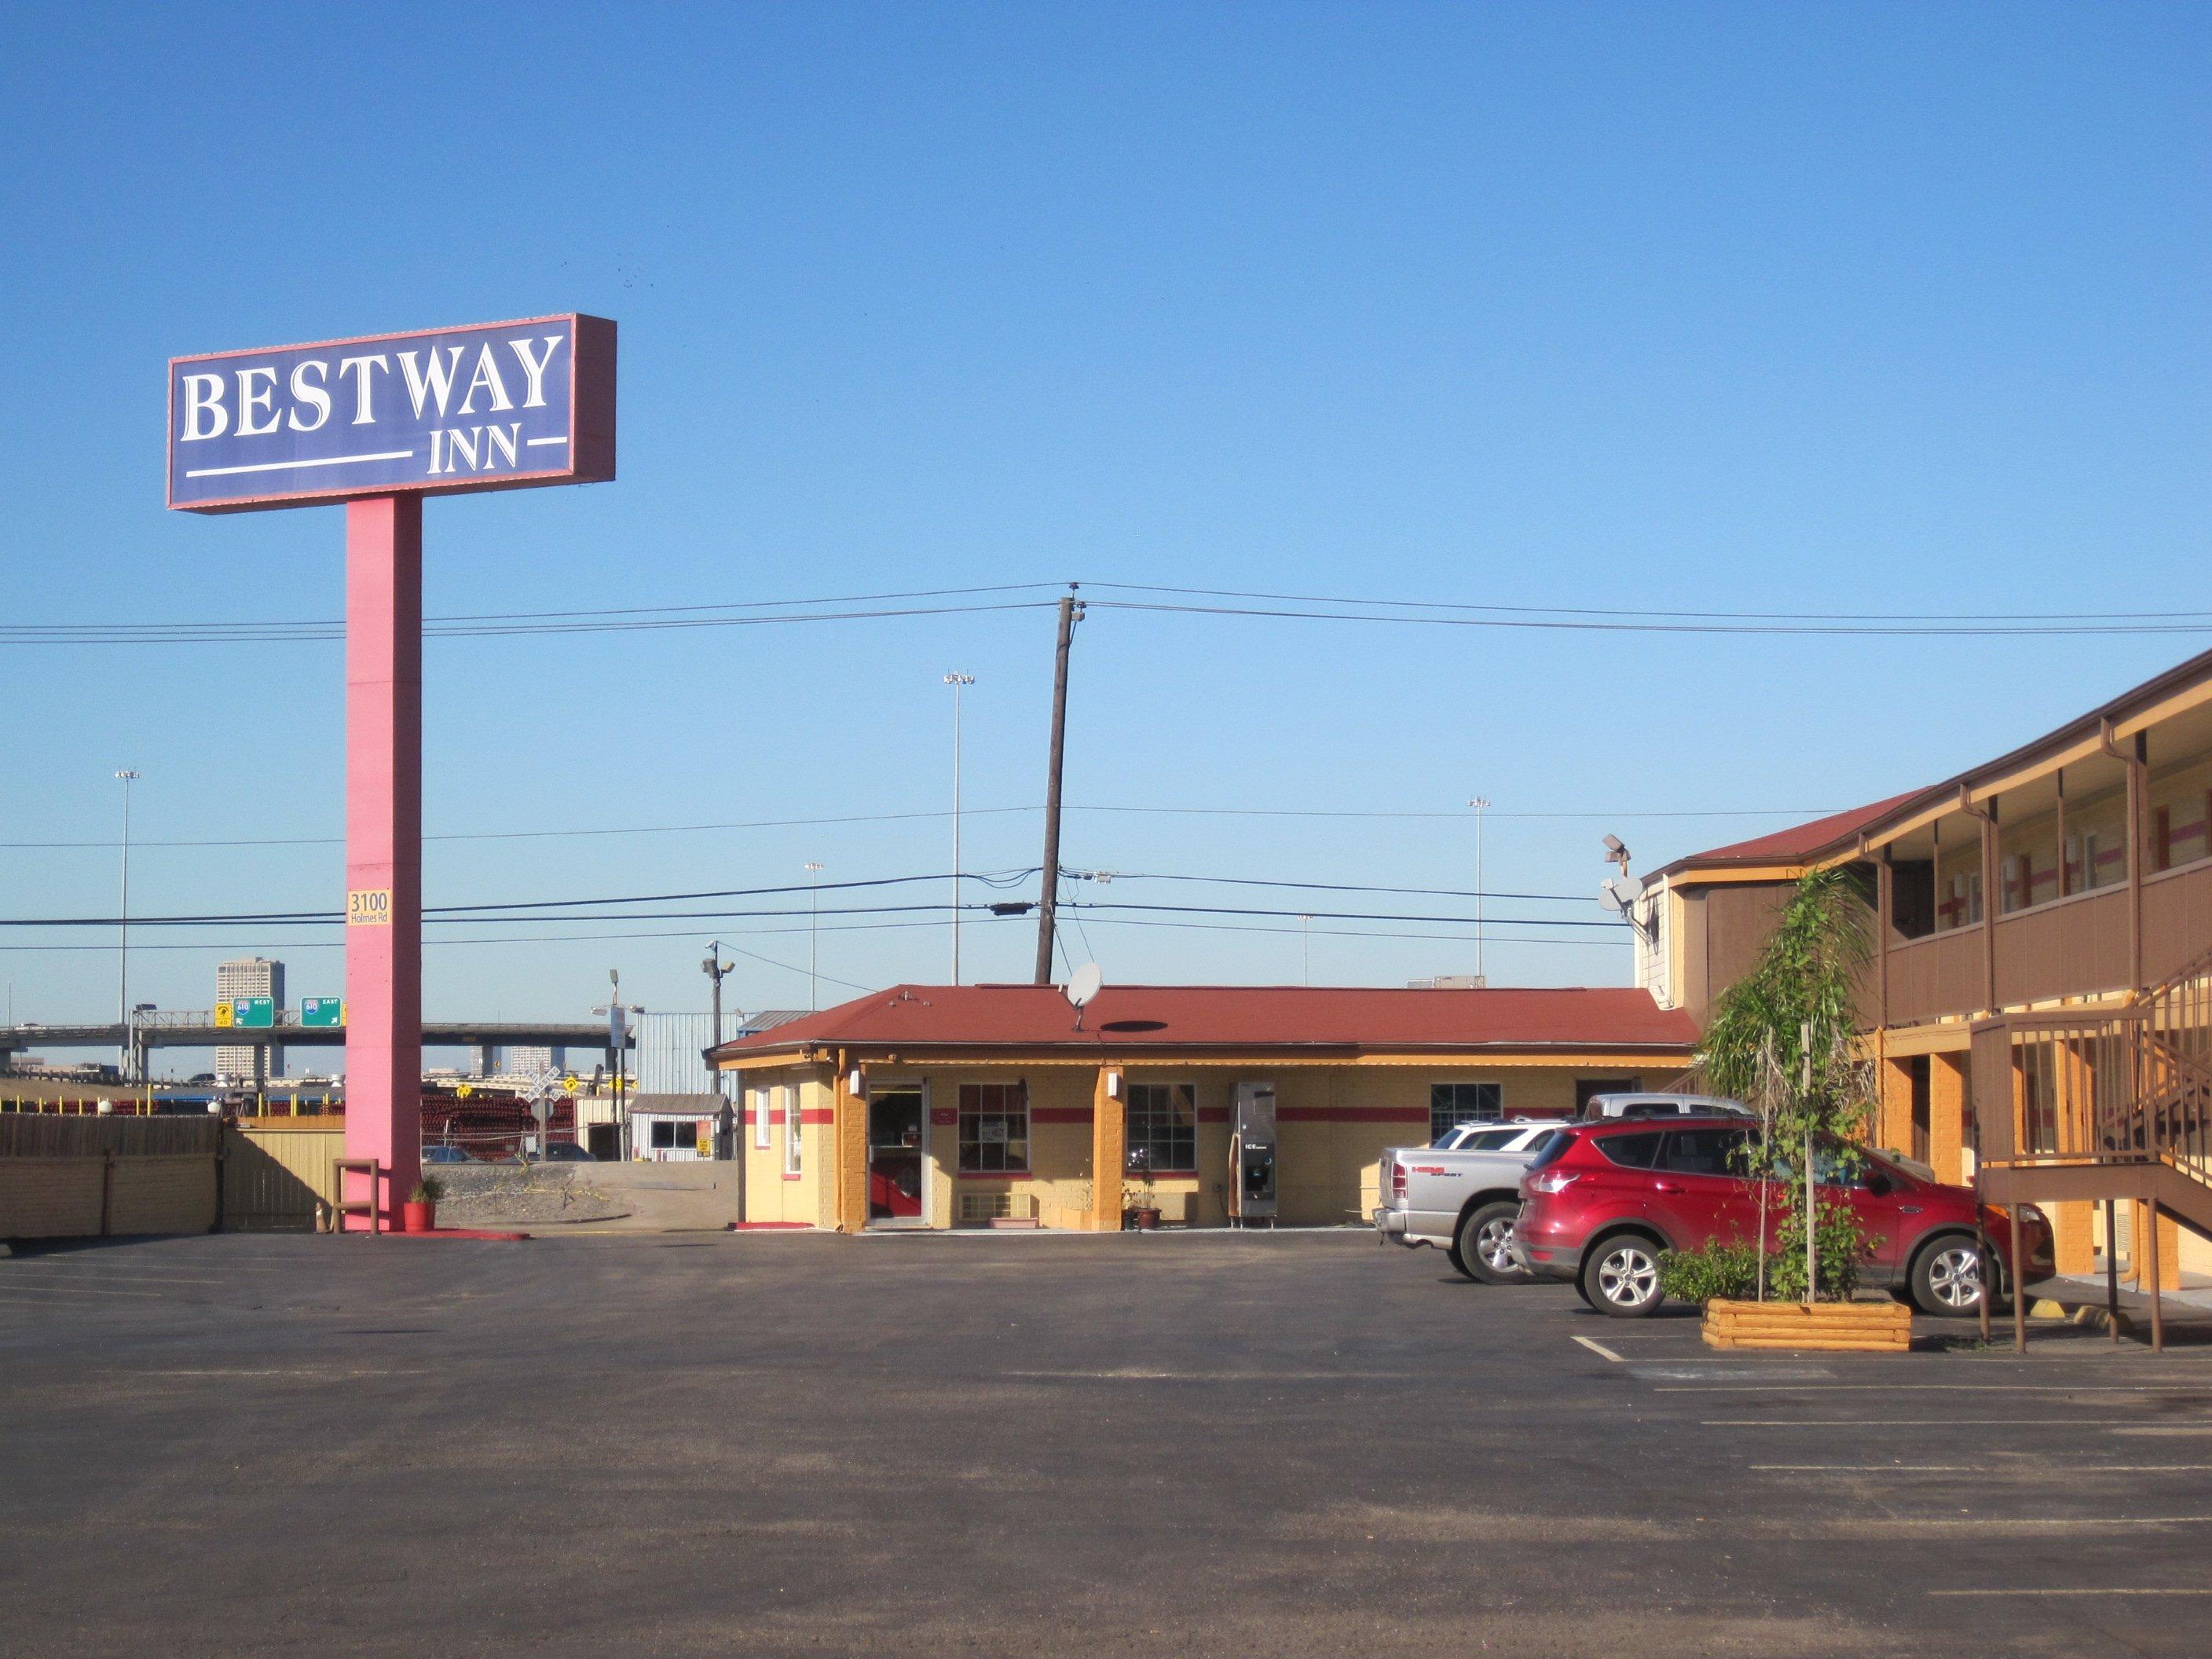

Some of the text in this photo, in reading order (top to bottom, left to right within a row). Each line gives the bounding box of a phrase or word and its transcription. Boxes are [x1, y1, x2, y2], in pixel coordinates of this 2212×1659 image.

[427, 422, 522, 474] INN
[351, 892, 387, 912] 3100
[351, 912, 387, 924] Holmes Rd
[237, 1002, 249, 1011] 610
[526, 1068, 559, 1101] CROSSING
